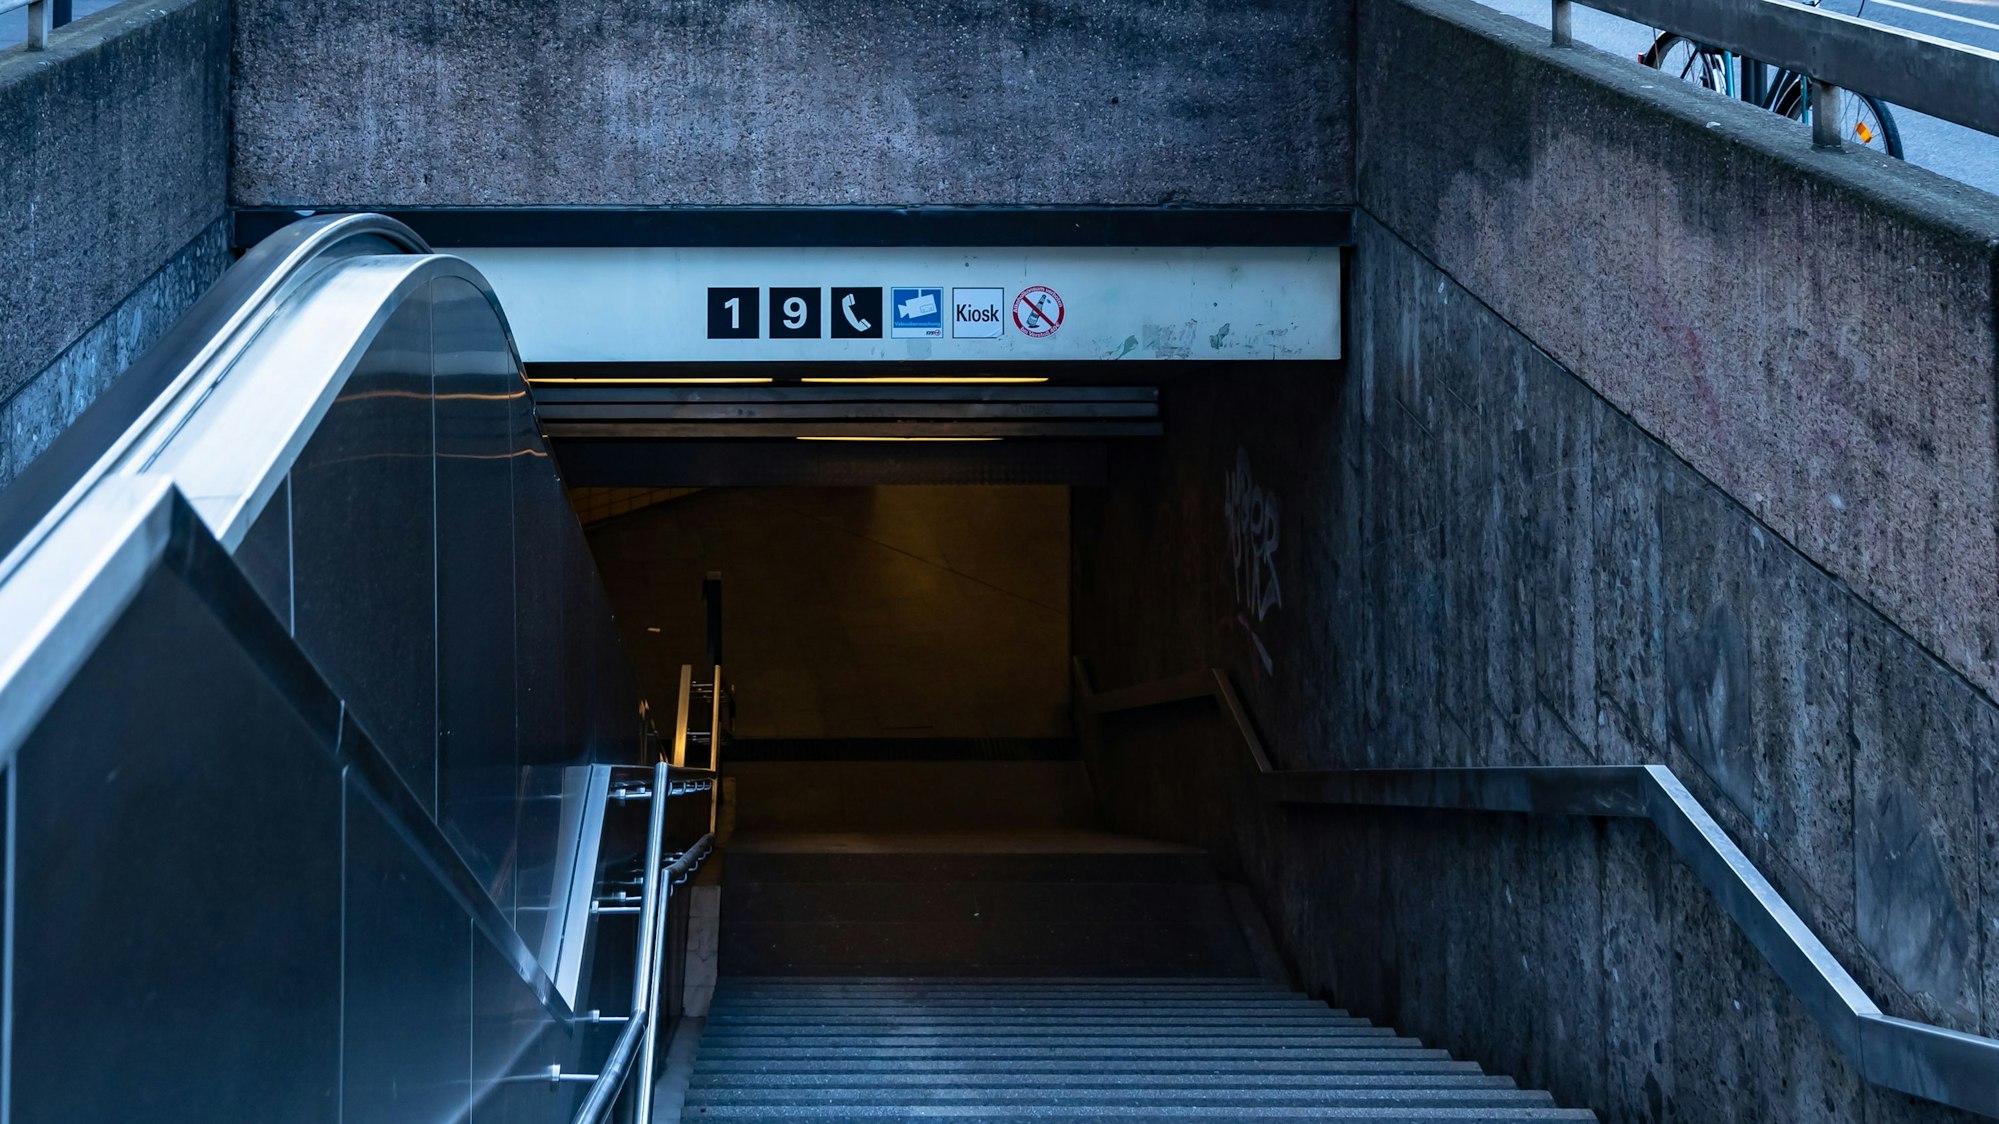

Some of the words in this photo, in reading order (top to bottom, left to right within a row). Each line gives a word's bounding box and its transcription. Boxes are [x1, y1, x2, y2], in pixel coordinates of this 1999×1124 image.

[724, 297, 740, 329] 1
[782, 297, 808, 329] 9
[956, 304, 1000, 322] Kiosk
